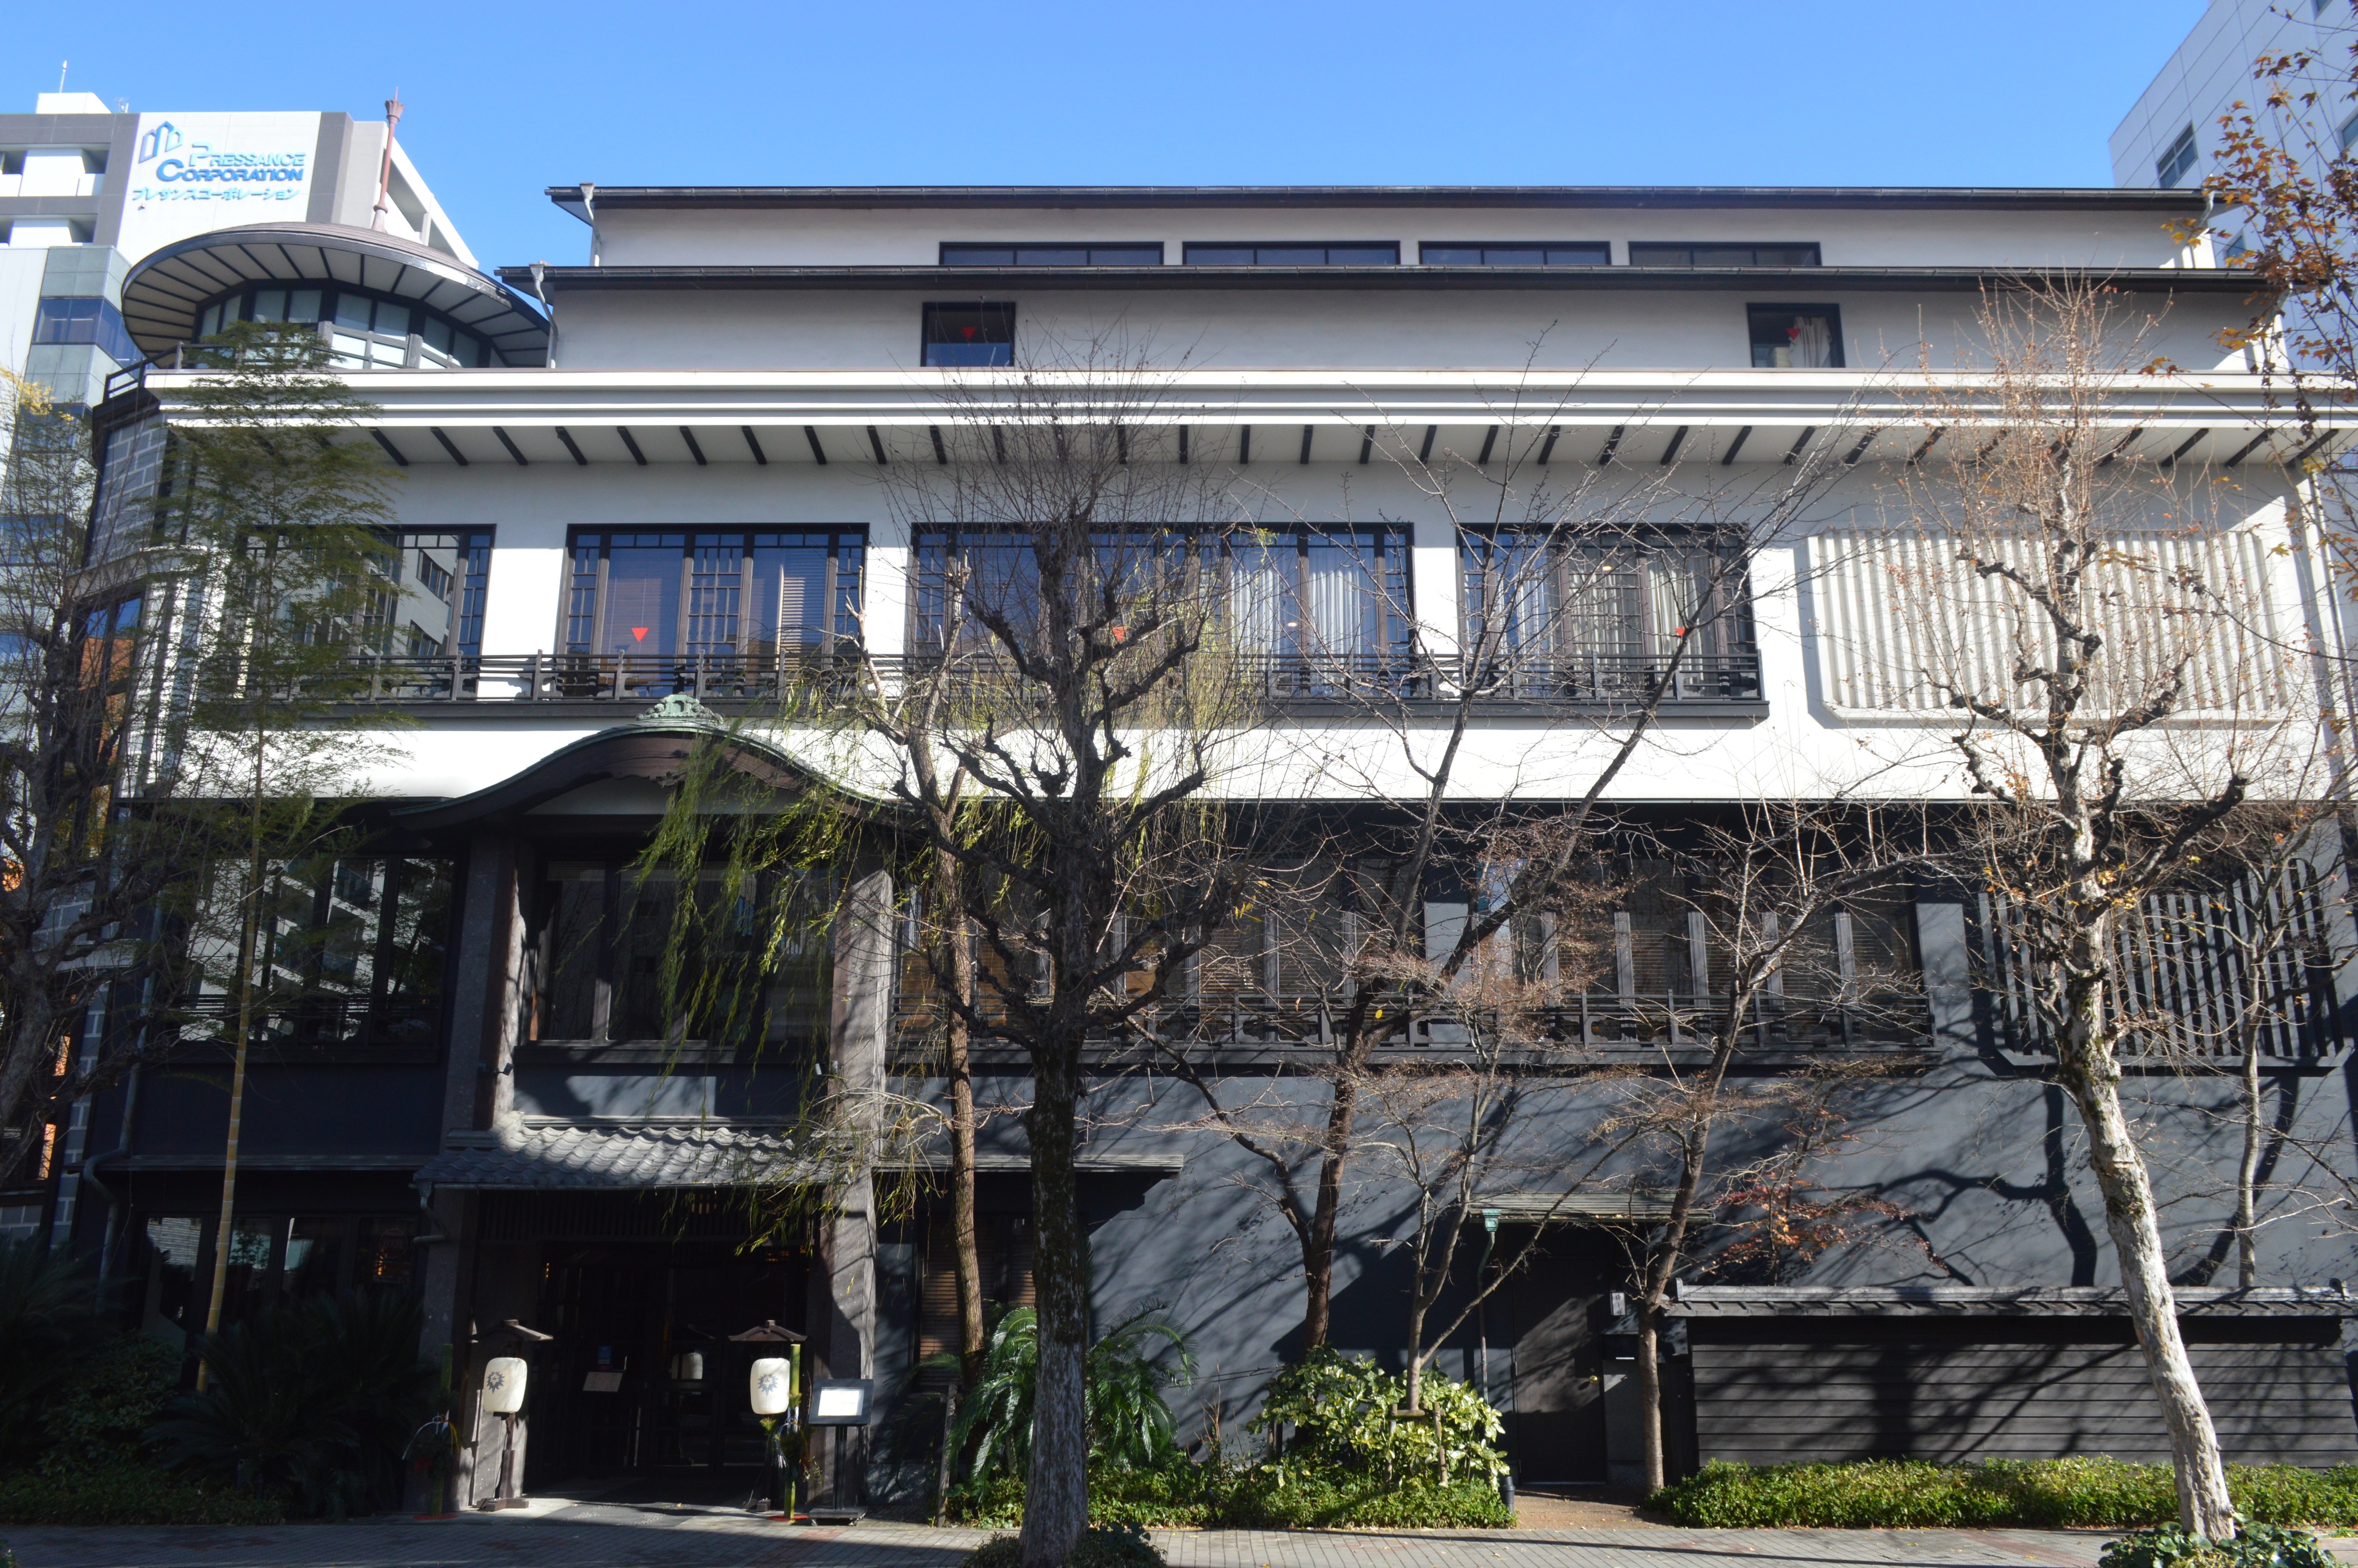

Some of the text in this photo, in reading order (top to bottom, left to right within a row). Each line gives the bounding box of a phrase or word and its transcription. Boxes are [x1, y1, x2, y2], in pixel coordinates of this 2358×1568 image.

[189, 141, 306, 167] PRESSANCE
[156, 159, 304, 182] CORPORATION
[132, 187, 300, 200] プレサンスコーポレーション
